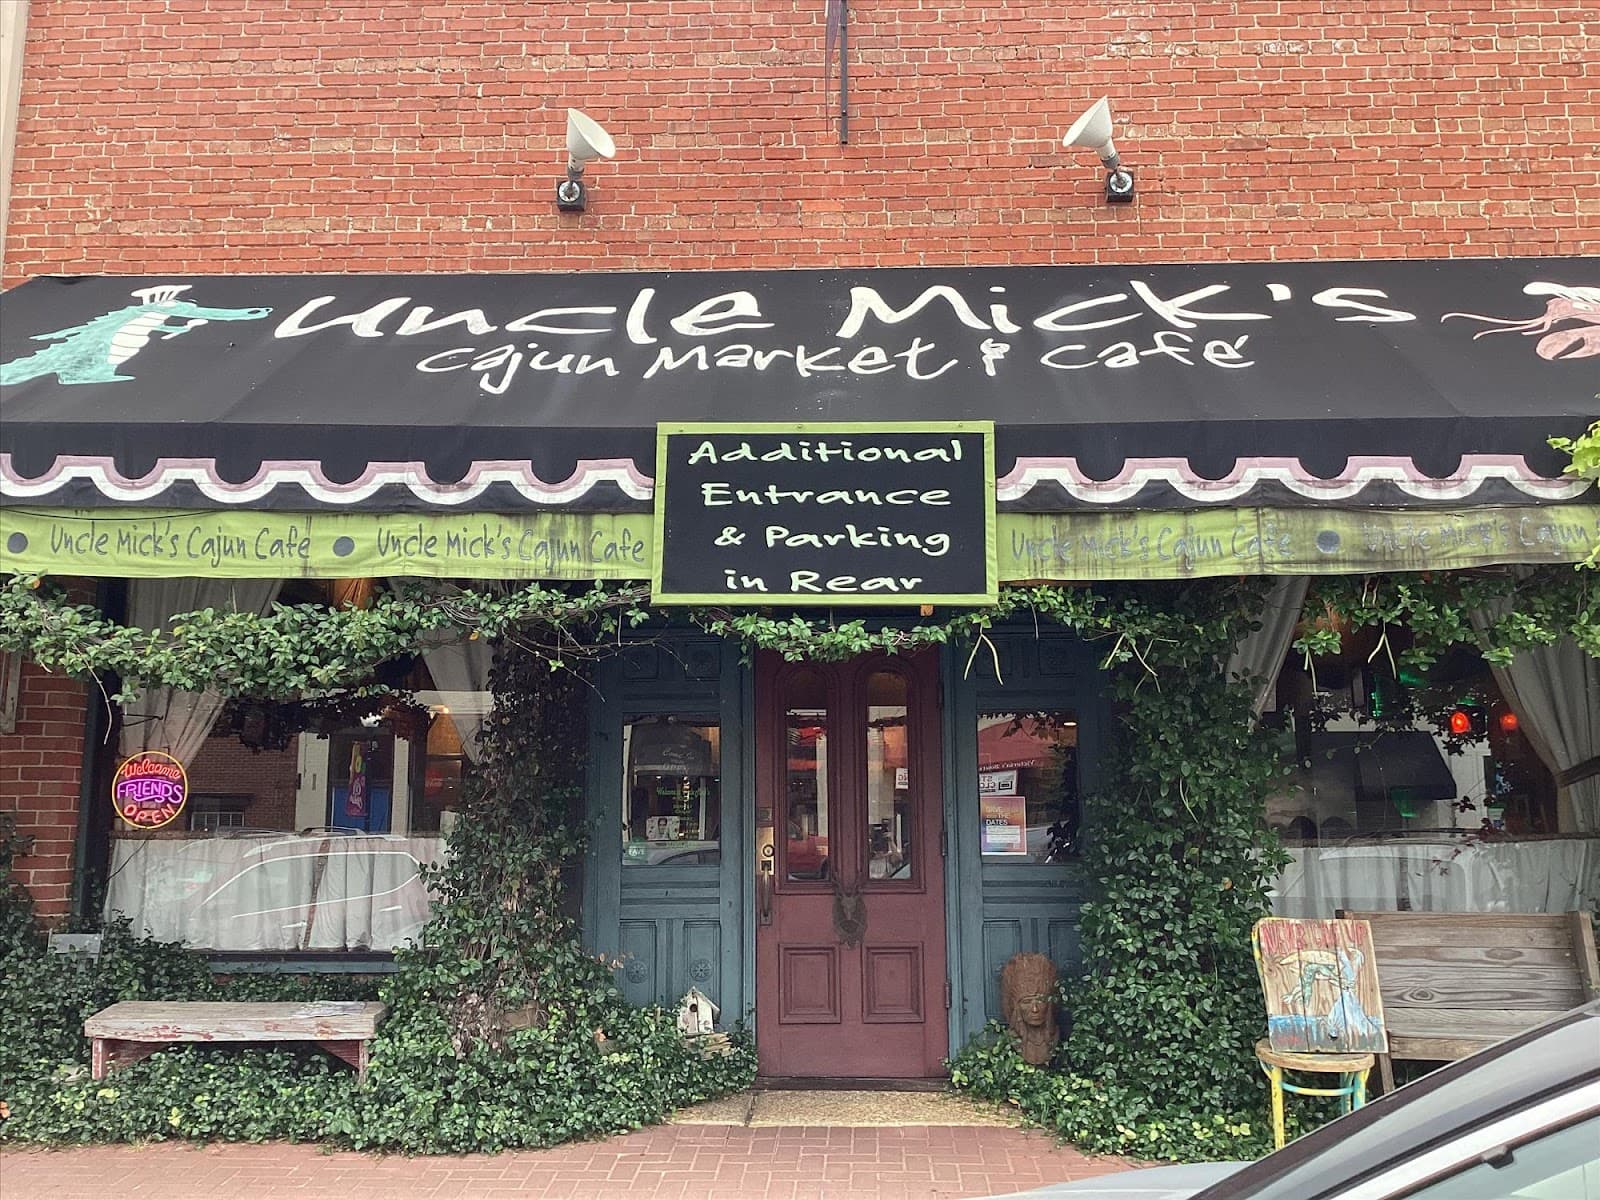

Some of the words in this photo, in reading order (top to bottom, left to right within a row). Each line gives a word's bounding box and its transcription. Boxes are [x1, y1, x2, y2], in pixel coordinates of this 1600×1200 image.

[643, 337, 959, 380] Market
[688, 439, 962, 465] Additional
[701, 482, 951, 506] Entrance
[51, 520, 109, 556] Uncle
[117, 521, 179, 558] Mick's
[187, 526, 247, 568] Cajun
[377, 523, 439, 558] Uncle
[447, 524, 512, 560] Mick's
[519, 528, 583, 574] Cajun
[590, 528, 645, 562] Cafe
[714, 526, 745, 546] &
[765, 524, 950, 556] Parking
[1012, 524, 1072, 560] Uncle
[1081, 524, 1149, 560] Mick's
[1157, 526, 1222, 570] Cajun
[1520, 517, 1590, 556] Cajun
[725, 569, 768, 592] in
[790, 570, 922, 592] Rear
[120, 758, 181, 780] Welcome
[117, 778, 184, 804] FRIENDS
[123, 803, 176, 825] OPEN
